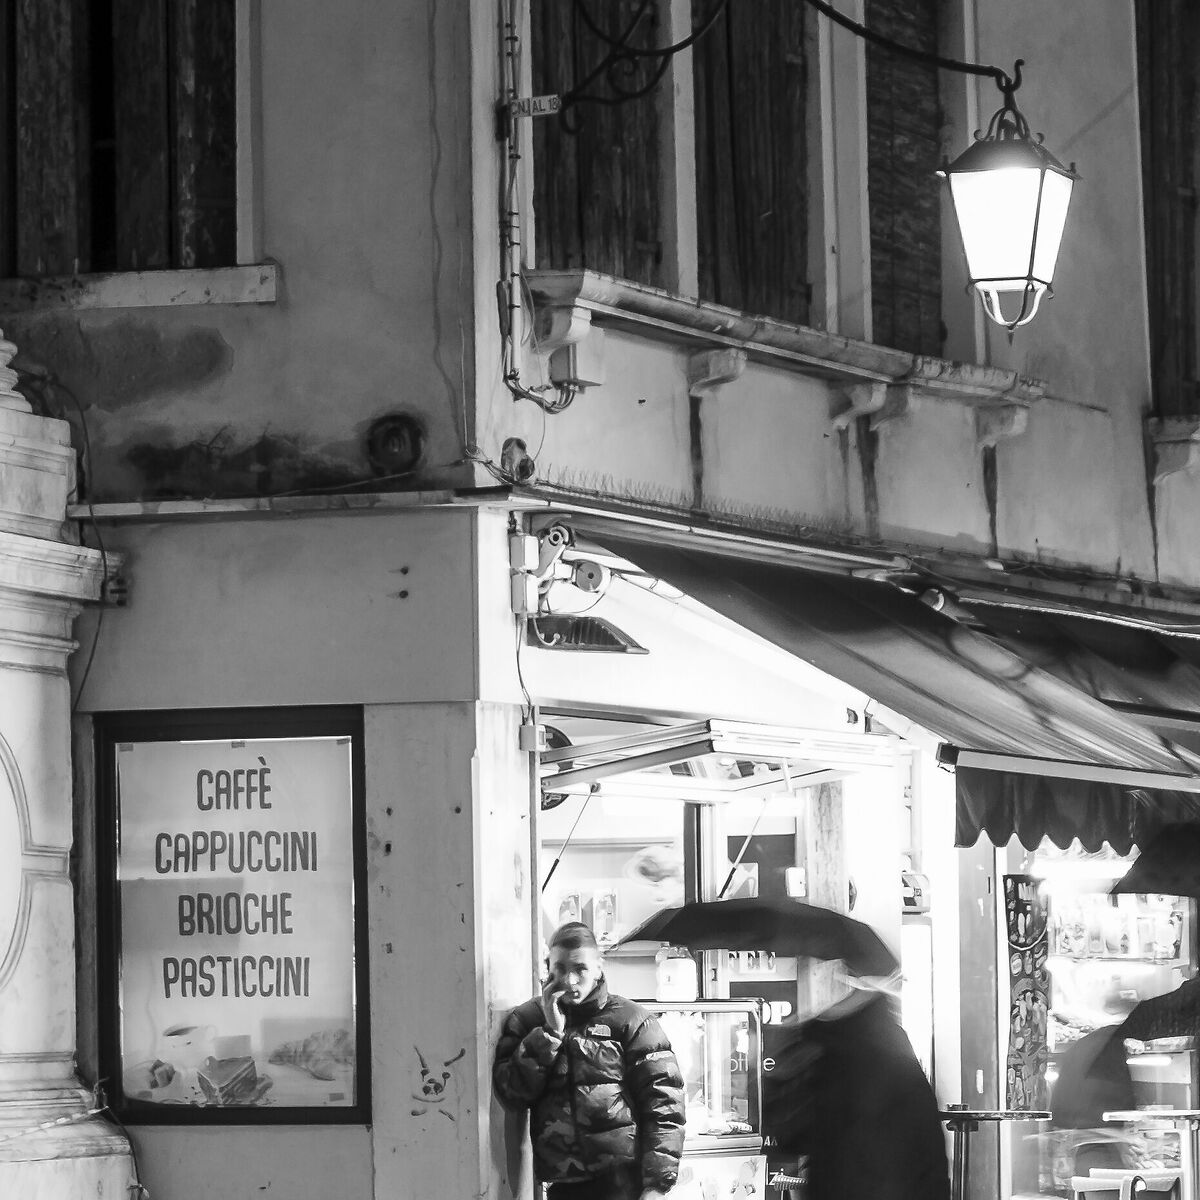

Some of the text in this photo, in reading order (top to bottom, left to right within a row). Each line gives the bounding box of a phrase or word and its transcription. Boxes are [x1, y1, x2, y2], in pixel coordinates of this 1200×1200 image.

[197, 756, 272, 811] CAFFÈ
[155, 831, 318, 874] CAPPUCCINI
[178, 892, 293, 936] BRIOCHE
[163, 955, 310, 998] PASTICCINI
